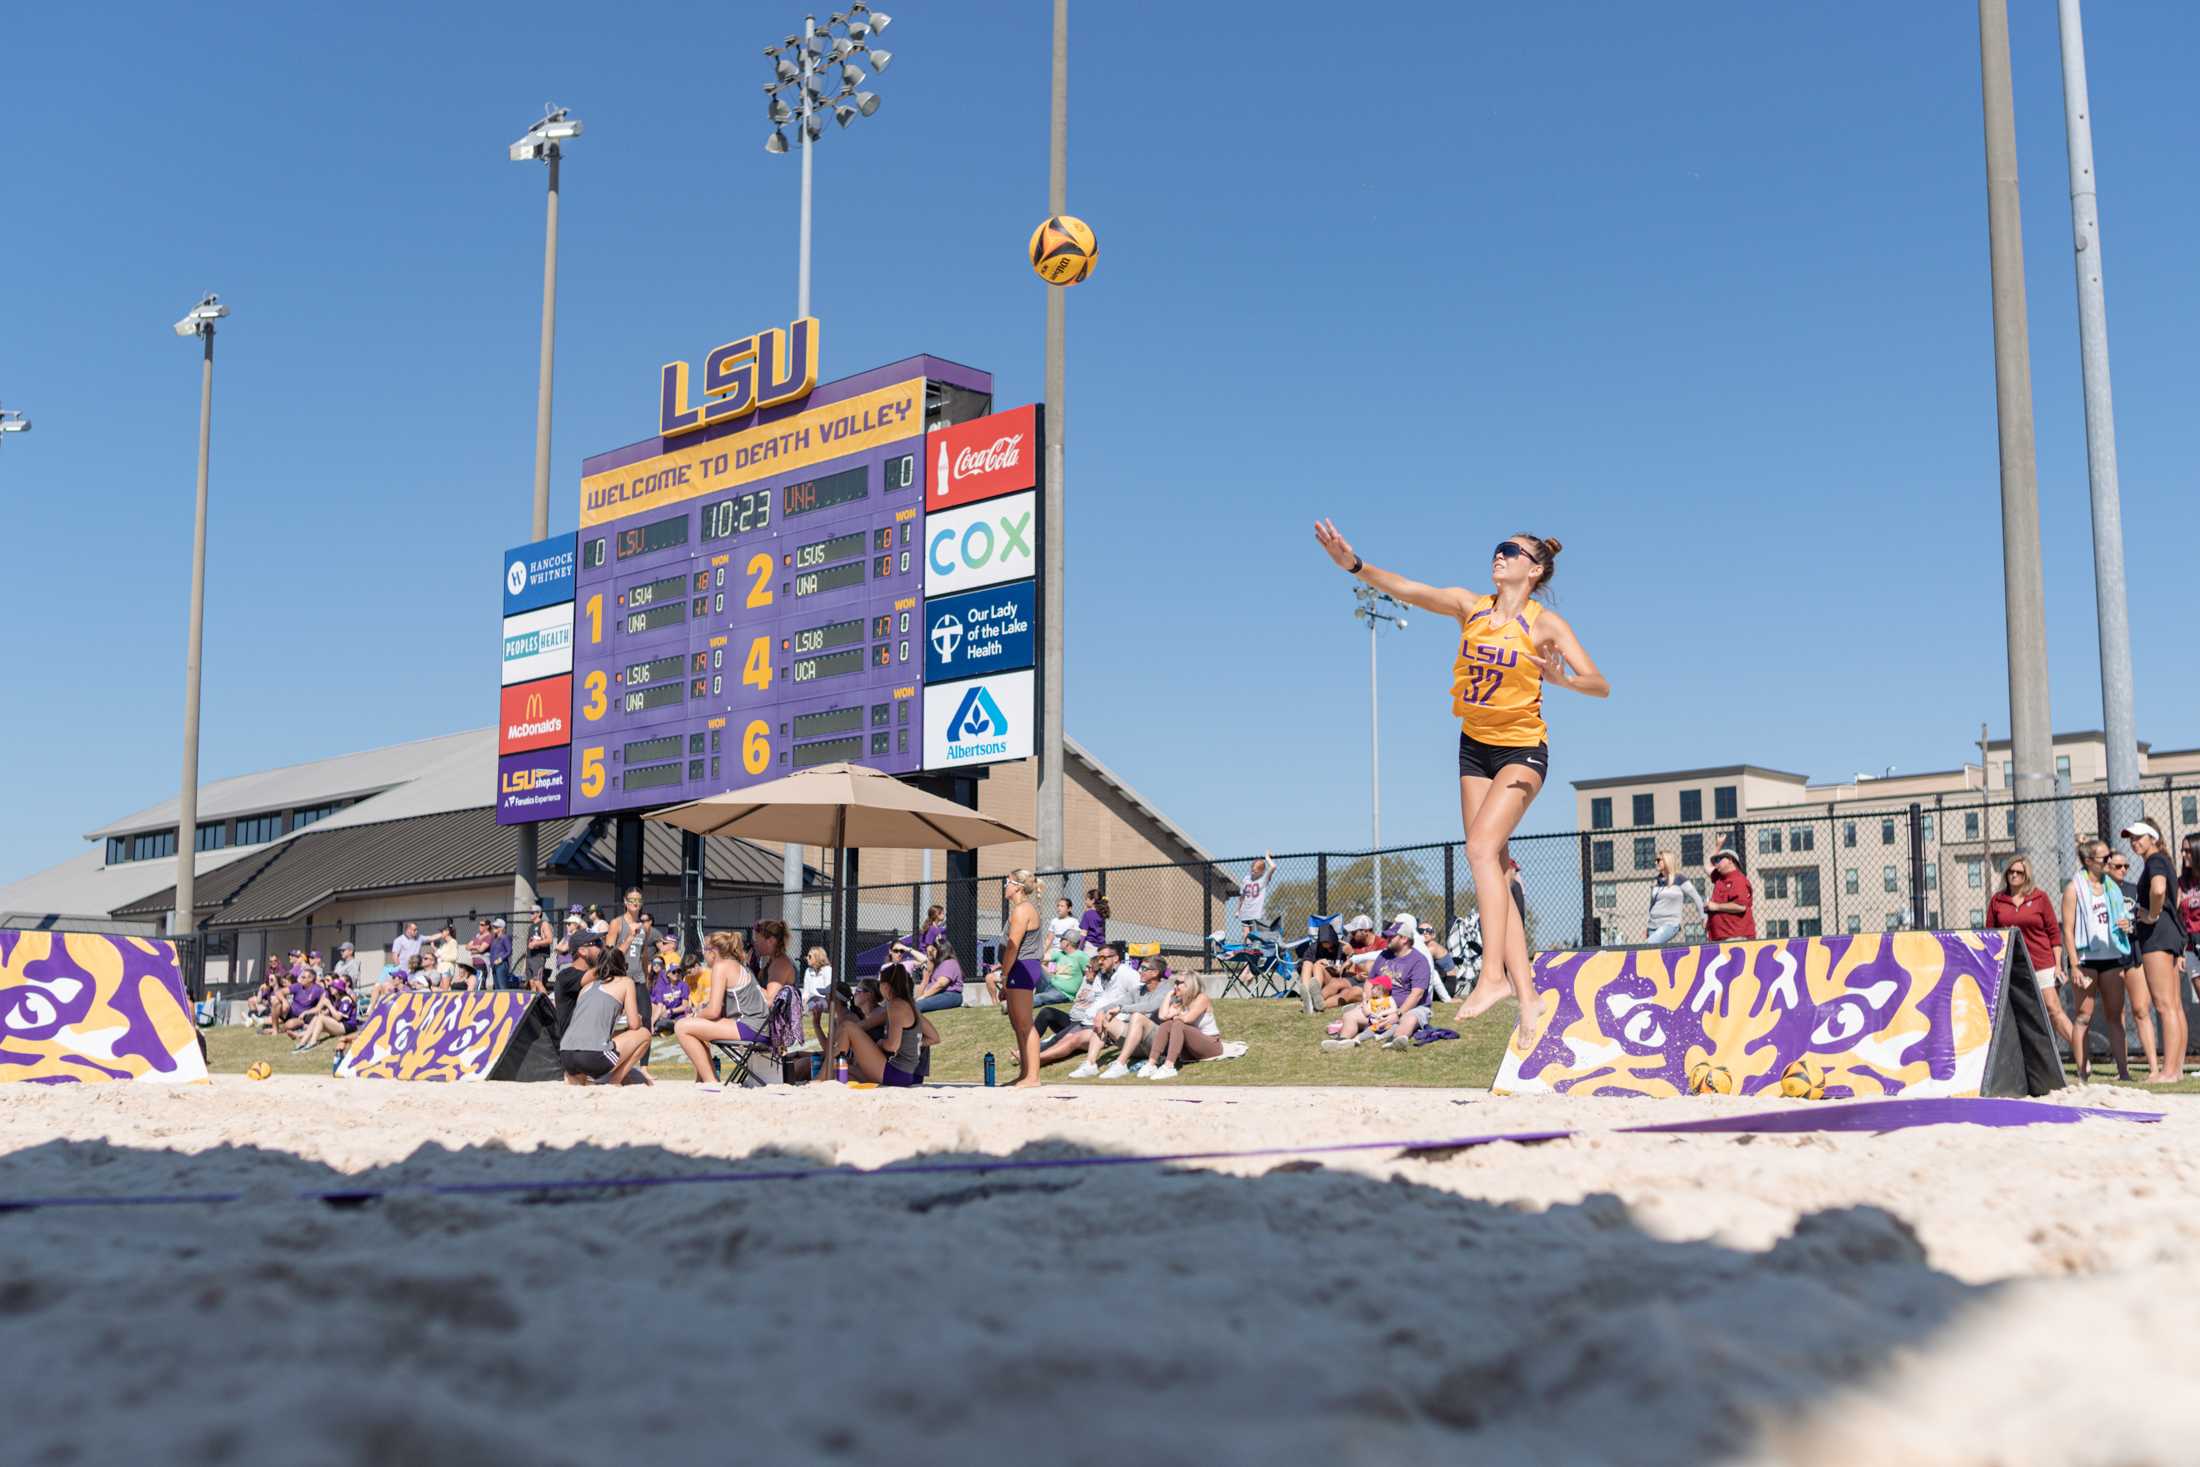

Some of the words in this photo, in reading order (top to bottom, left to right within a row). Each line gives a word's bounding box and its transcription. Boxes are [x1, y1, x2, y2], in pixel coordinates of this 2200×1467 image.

[660, 317, 819, 437] LSU
[587, 464, 692, 511] WELCOME
[699, 453, 729, 478] TO
[736, 428, 810, 469] DEATH
[819, 398, 912, 444] VOLLEY
[900, 455, 913, 487] 0
[784, 481, 816, 513] UNA
[711, 490, 771, 538] 10:23
[895, 508, 917, 522] WON
[595, 538, 606, 567] 0
[617, 527, 645, 559] LSU
[929, 511, 1031, 576] COX
[530, 551, 573, 573] HANCOCK
[901, 551, 910, 572] 0
[530, 564, 573, 585] WHITNEY
[747, 553, 774, 608] 2
[796, 573, 818, 596] UNA
[629, 586, 652, 608] LSU4
[715, 593, 724, 612] 0
[895, 596, 916, 611] WON
[586, 592, 603, 644] 1
[900, 612, 910, 633] 0
[967, 608, 989, 623] Our
[991, 601, 1018, 619] Lady
[628, 614, 646, 633] UNA
[967, 627, 980, 641] of
[981, 623, 999, 639] the
[1001, 617, 1028, 635] Lake
[505, 634, 539, 657] PEOPLES
[540, 628, 569, 649] HEALTH
[899, 641, 909, 661] 0
[967, 641, 1002, 659] Health
[1462, 639, 1518, 668] LSU
[714, 649, 723, 668] 0
[742, 635, 773, 691] 4
[626, 664, 650, 686] LSU6
[794, 661, 816, 682] UCA
[583, 670, 608, 721] 3
[713, 675, 722, 695] 0
[893, 687, 915, 699] WON
[1463, 664, 1504, 707] 32
[626, 693, 644, 712] UNA
[507, 718, 562, 740] McDonald's
[708, 718, 726, 729] WON
[742, 719, 771, 775] 6
[946, 741, 1007, 760] Albertsons
[580, 746, 606, 798] 5
